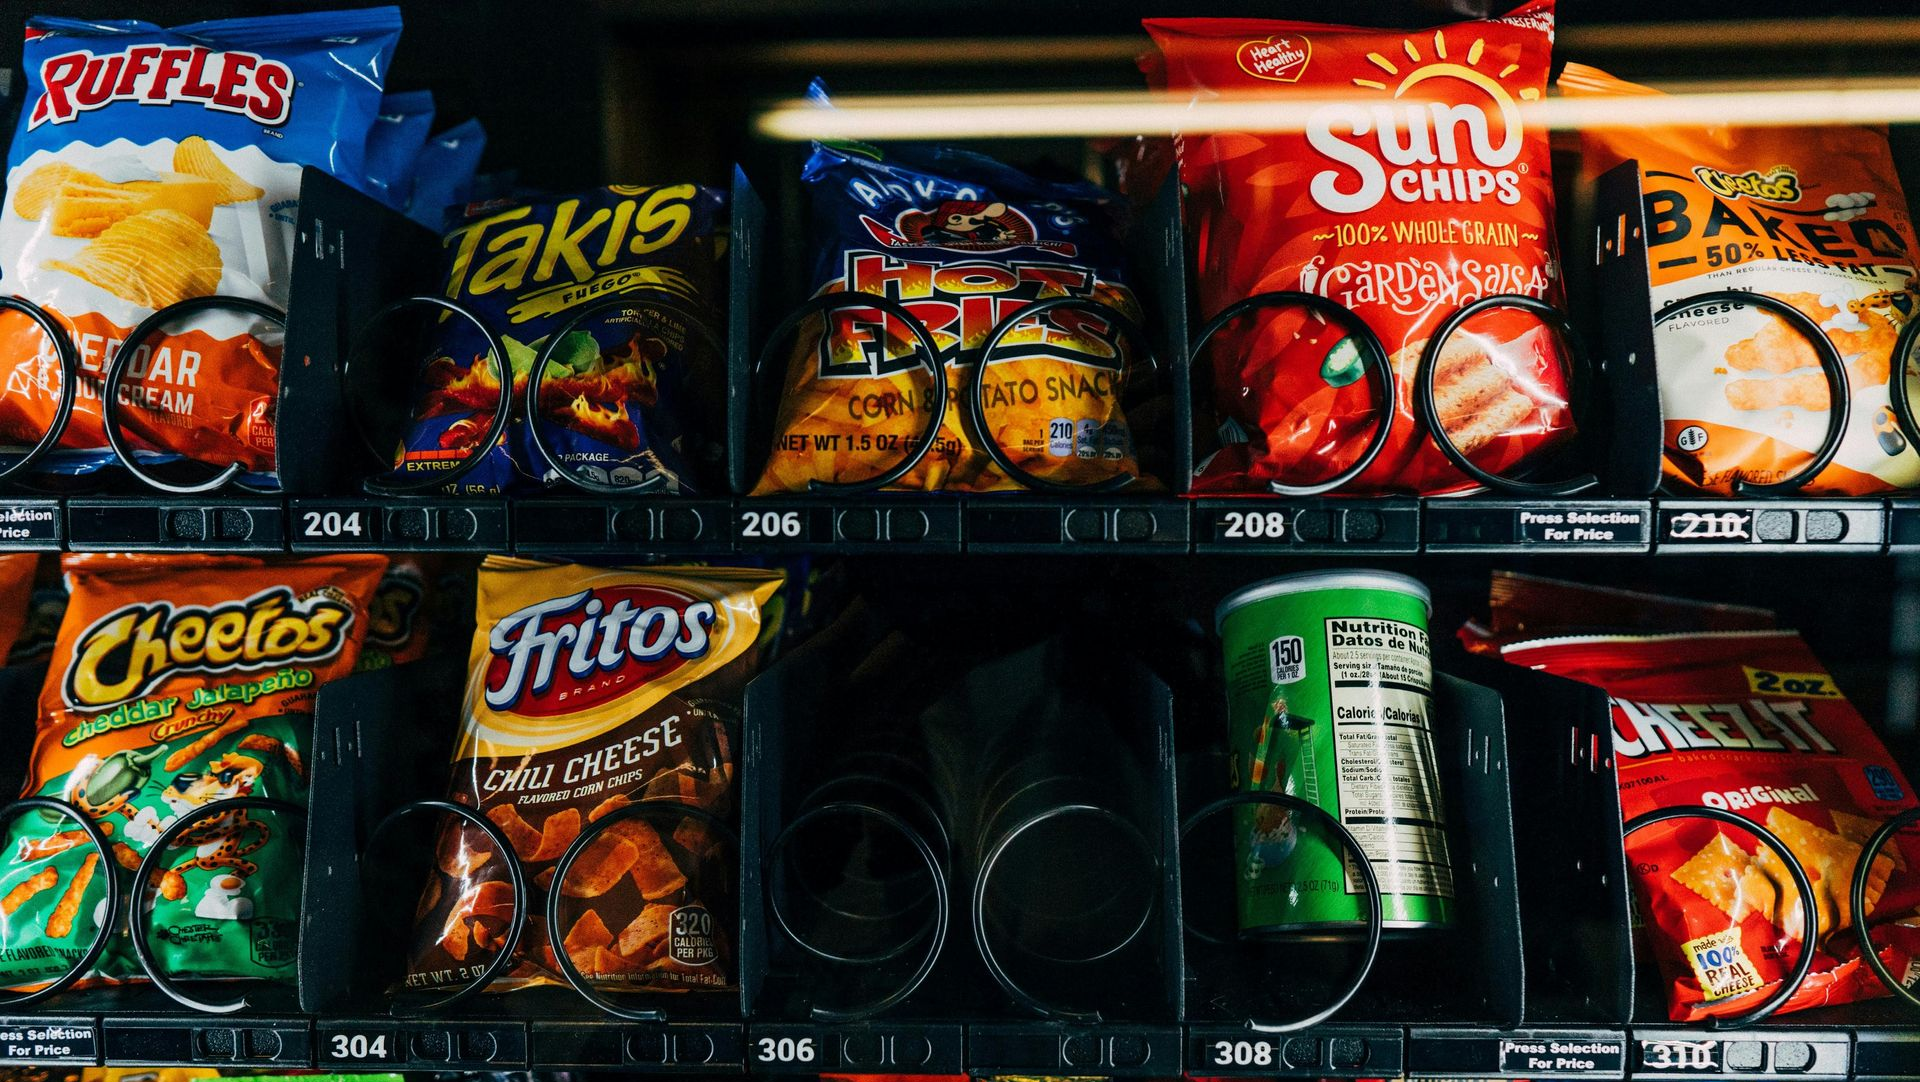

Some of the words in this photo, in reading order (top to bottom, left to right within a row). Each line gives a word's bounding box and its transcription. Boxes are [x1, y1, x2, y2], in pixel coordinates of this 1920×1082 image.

[1250, 38, 1291, 60] Heart
[1253, 47, 1304, 76] Healthy
[29, 45, 293, 130] RUFFLES
[1306, 101, 1523, 214] Sun
[1390, 167, 1521, 204] CHIPS
[1695, 165, 1801, 203] Cheetos
[1334, 223, 1388, 248] 100%
[1392, 221, 1456, 247] WHOLE
[1462, 222, 1518, 248] GRAIN
[1642, 189, 1909, 260] BAKED
[1706, 242, 1764, 268] 50%
[1772, 245, 1830, 270] LESS
[1834, 262, 1879, 278] FAT
[846, 250, 1096, 300] HOT
[1707, 271, 1732, 280] THAN
[1736, 266, 1777, 275] REGULAR
[1780, 266, 1812, 275] CHEESE
[562, 273, 632, 305] FUEGO
[818, 296, 1124, 379] FRIES
[1668, 318, 1730, 332] FLAVORED
[118, 384, 194, 416] CREAM
[848, 391, 914, 420] CORN
[949, 377, 1038, 414] PTATO
[1050, 423, 1073, 439] 210
[776, 433, 810, 453] NET
[814, 433, 842, 452] WT
[846, 434, 872, 451] 1.5
[876, 433, 899, 451] OZ
[903, 433, 963, 456] (4.5g)
[406, 461, 461, 472] EXTREM
[564, 453, 609, 462] PACKAGE
[0, 510, 53, 522] election
[303, 511, 362, 537] 204
[741, 511, 801, 538] 206
[1224, 511, 1285, 538] 208
[1520, 512, 1564, 525] Press
[1567, 511, 1640, 525] Selection
[1680, 512, 1741, 538] 210
[1544, 528, 1571, 541] For
[1574, 527, 1614, 541] Price
[1331, 620, 1416, 641] Nutrition
[1332, 634, 1383, 648] Datos
[1388, 637, 1405, 650] de
[66, 588, 352, 709] Cheetos
[484, 587, 717, 713] Fritos
[1272, 638, 1302, 667] 150
[1276, 664, 1300, 674] CALORIES
[1277, 673, 1286, 681] PER
[1333, 662, 1361, 671] Serving
[187, 668, 313, 709] Jalapeño
[559, 674, 626, 701] BRAND
[151, 706, 234, 741] Crunchy
[484, 763, 555, 793] CHILI
[563, 714, 683, 784] CHEESE
[518, 789, 571, 805] FLAVORED
[573, 781, 604, 798] CORN
[608, 768, 643, 789] CHIPS
[1309, 880, 1319, 891] OZ
[1320, 879, 1340, 893] (71g)
[676, 912, 711, 935] 320
[5, 945, 55, 961] FLAVORED
[677, 948, 694, 958] PER
[697, 948, 714, 958] PKG
[1693, 939, 1717, 953] made
[1696, 945, 1740, 970] 100%
[460, 967, 470, 979] 2
[0, 1031, 24, 1041] ess
[27, 1029, 92, 1041] Selection
[331, 1034, 388, 1059] 304
[8, 1044, 31, 1056] For
[34, 1044, 71, 1056] Price
[757, 1038, 815, 1062] 306
[1213, 1040, 1272, 1067] 308
[1504, 1043, 1547, 1055] Press
[1549, 1042, 1620, 1055] Selection
[1652, 1044, 1711, 1070] 310
[1528, 1057, 1555, 1070] For
[1557, 1057, 1595, 1070] Price
